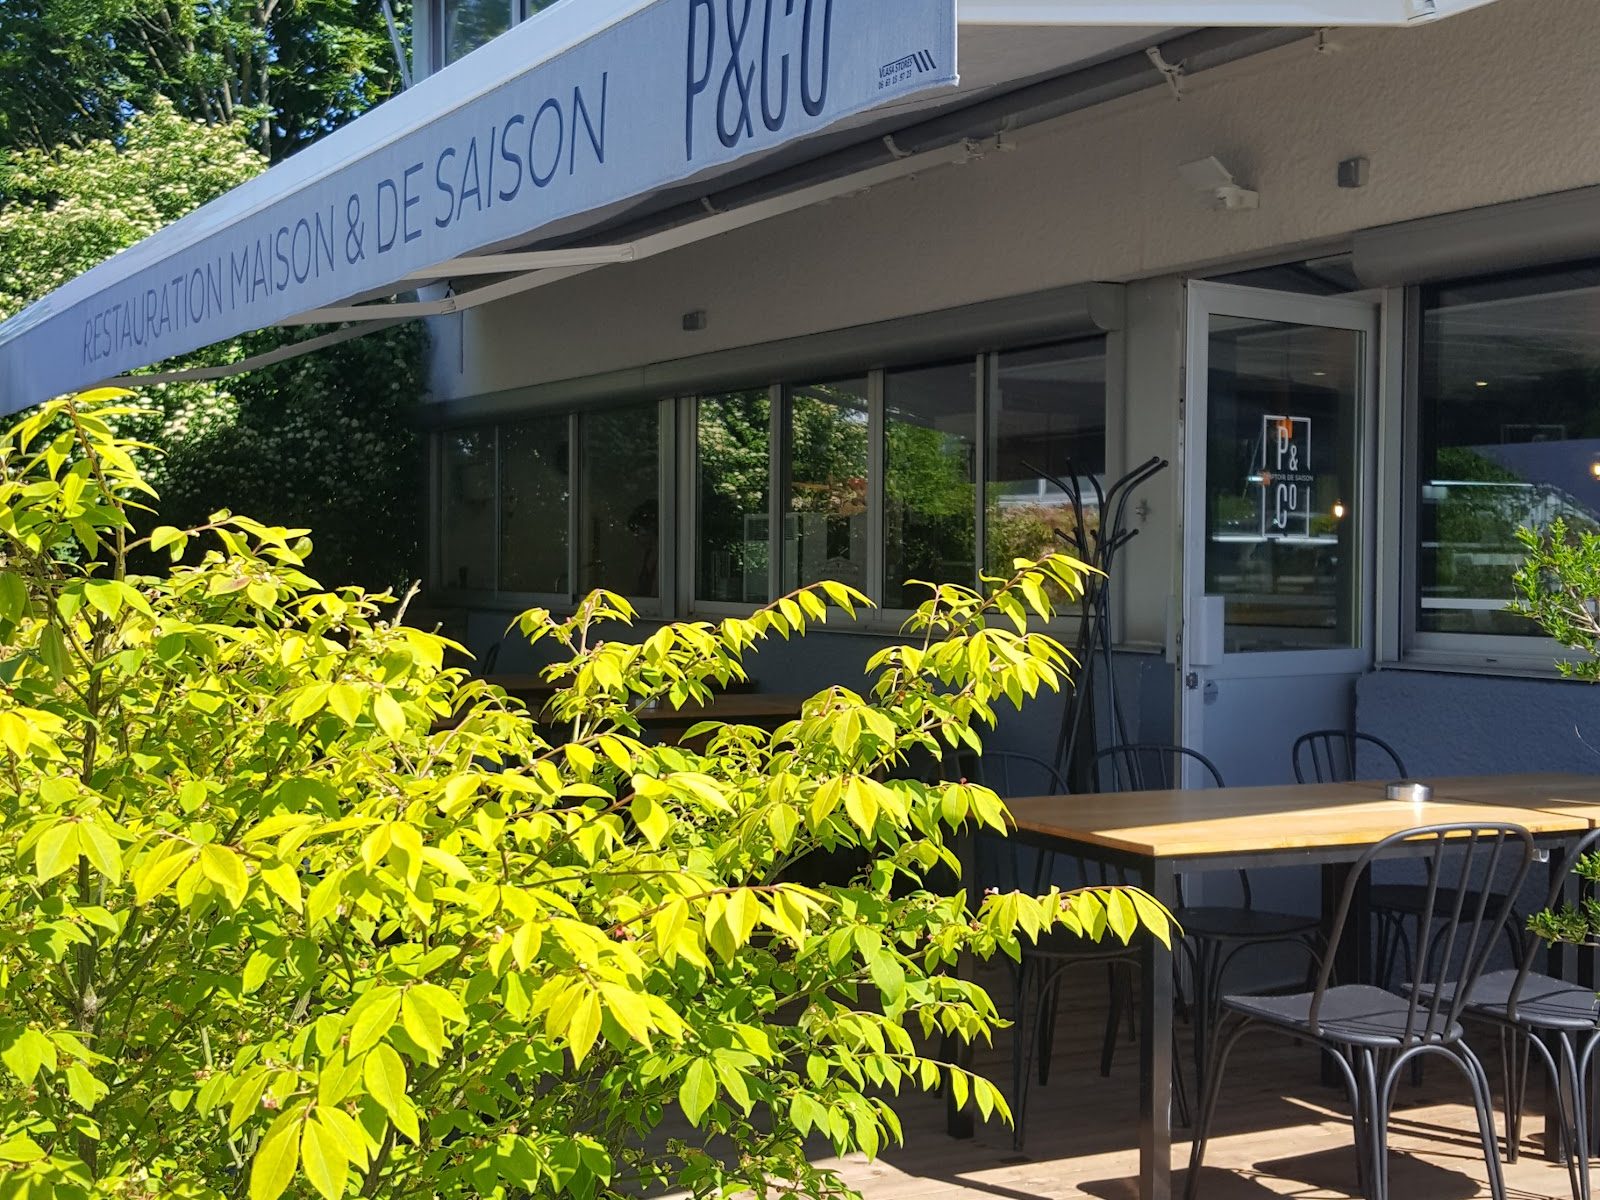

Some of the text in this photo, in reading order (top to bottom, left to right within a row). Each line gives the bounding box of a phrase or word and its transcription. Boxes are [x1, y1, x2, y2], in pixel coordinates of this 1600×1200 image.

[82, 71, 608, 366] RESTAURATION MAISON & DE SAISON
[1295, 474, 1313, 482] SAISON
